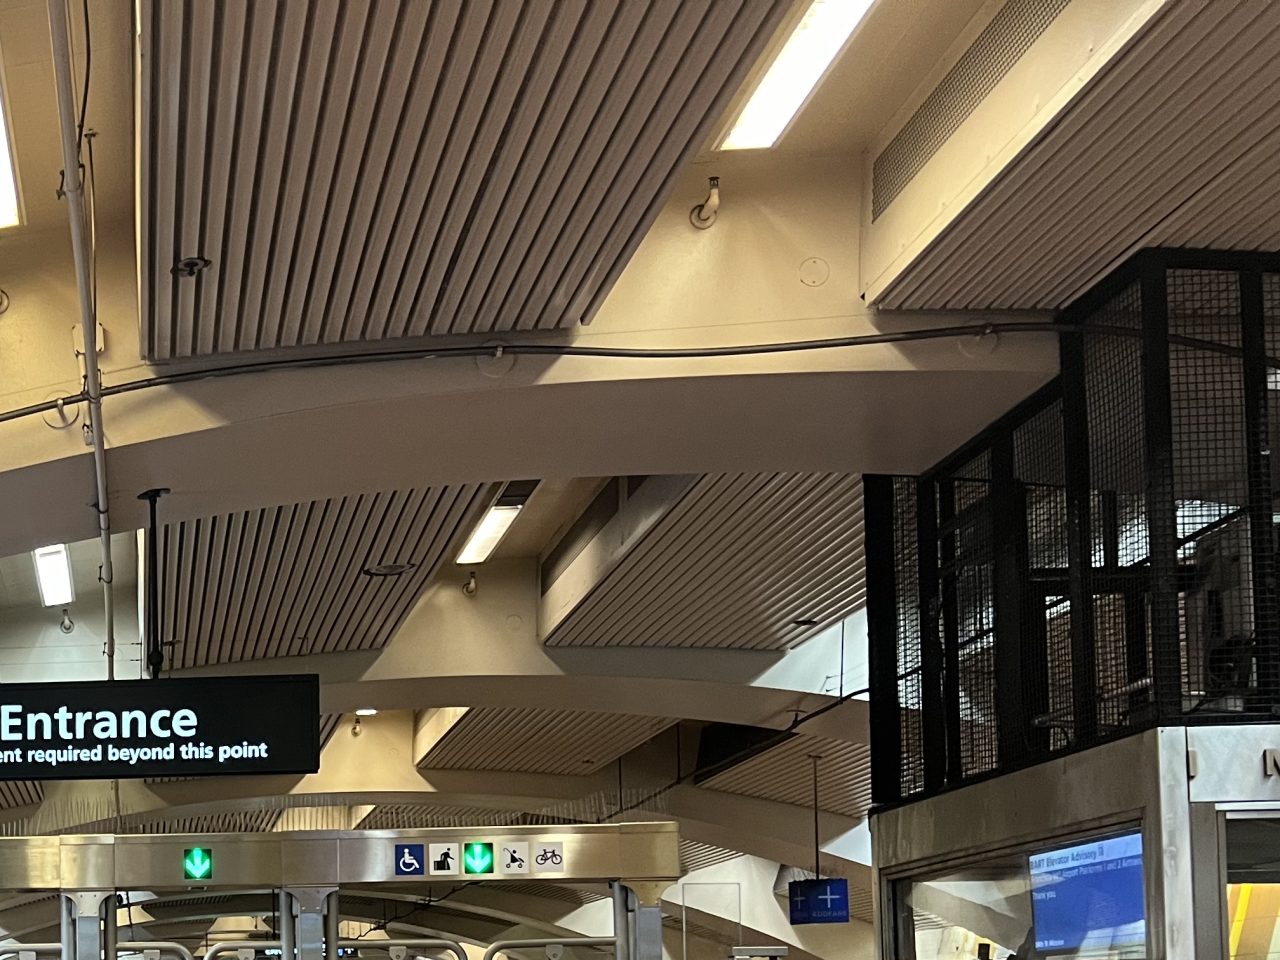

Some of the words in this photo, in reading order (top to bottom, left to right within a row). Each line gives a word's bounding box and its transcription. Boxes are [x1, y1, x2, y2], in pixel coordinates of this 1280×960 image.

[0, 705, 198, 741] Entrance
[27, 745, 102, 766] required
[107, 743, 175, 764] beyond
[179, 741, 214, 760] this
[218, 741, 269, 762] point
